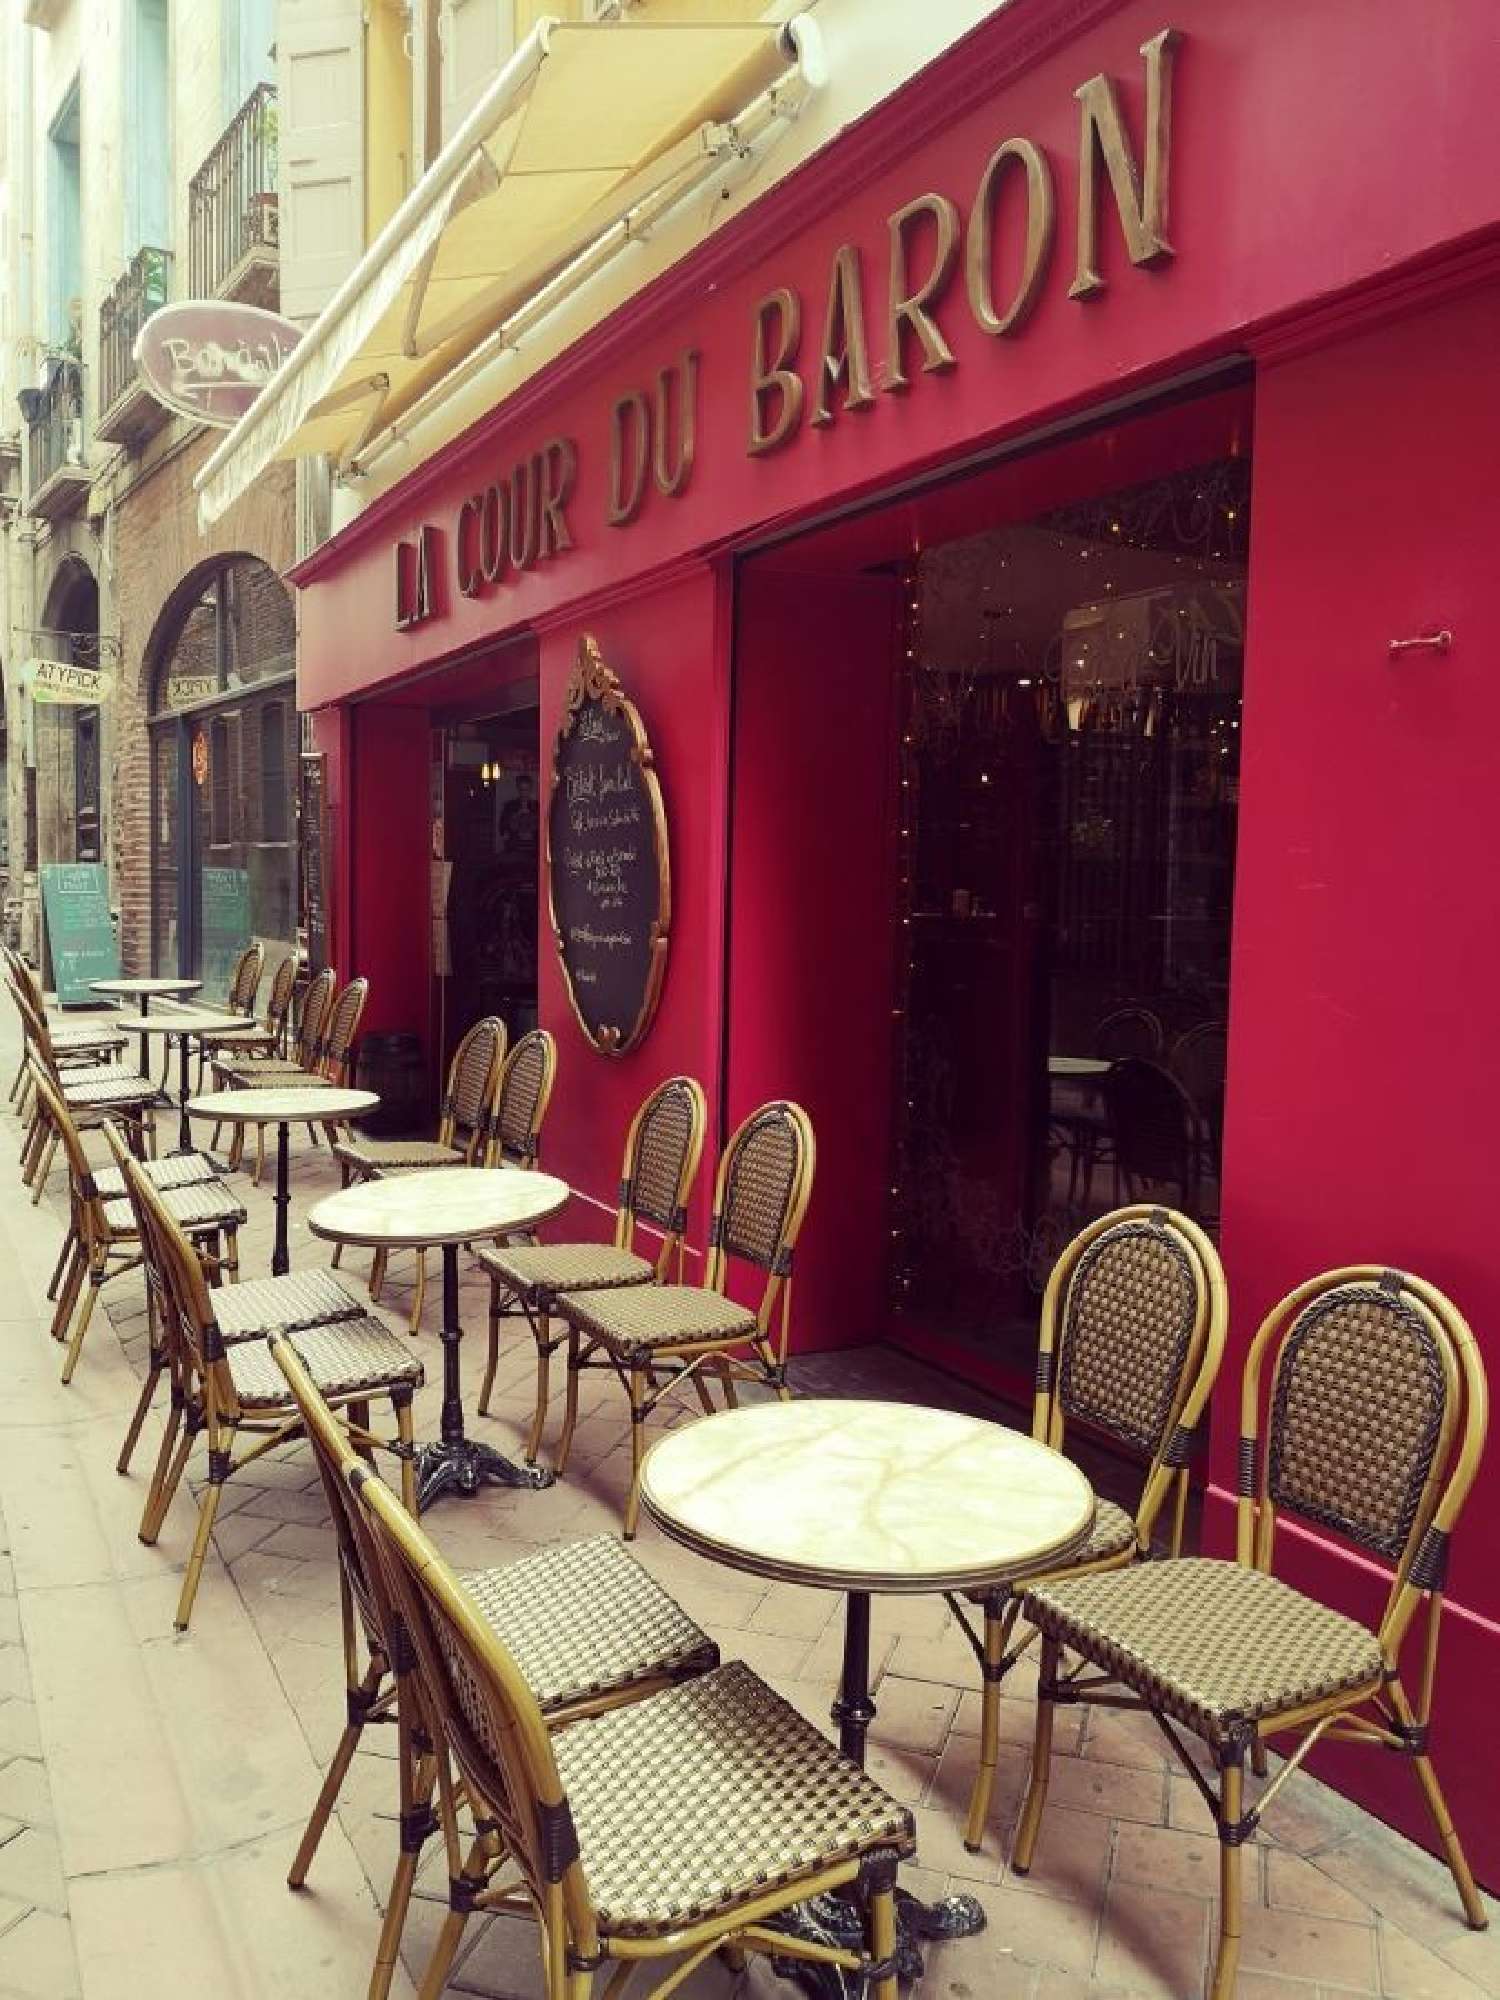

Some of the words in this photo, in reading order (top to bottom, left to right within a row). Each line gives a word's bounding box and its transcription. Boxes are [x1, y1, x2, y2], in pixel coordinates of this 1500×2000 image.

[392, 523, 443, 632] LA
[457, 437, 578, 600] COUR
[608, 347, 699, 527] DU
[746, 27, 1183, 457] BARON
[36, 662, 102, 690] ATYPICK
